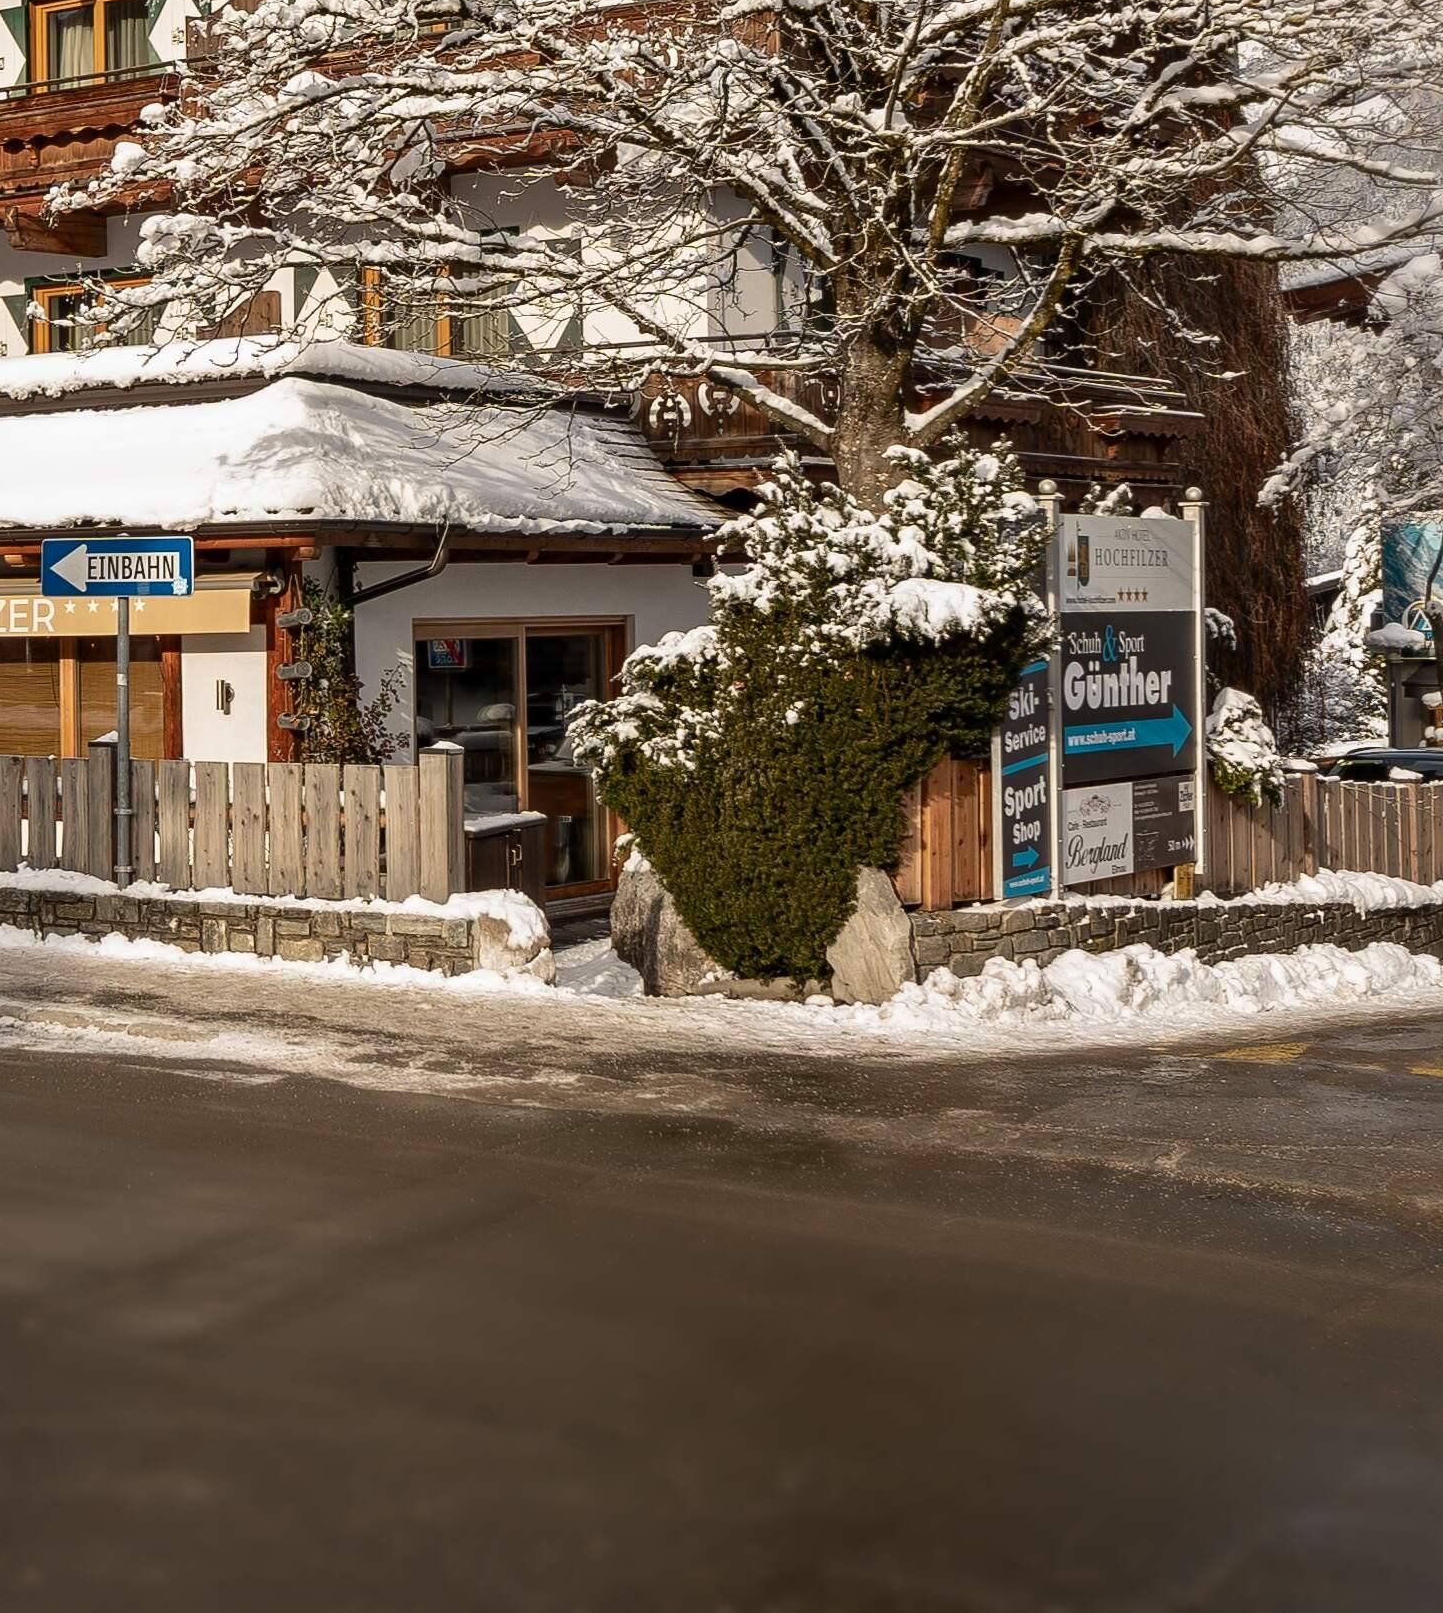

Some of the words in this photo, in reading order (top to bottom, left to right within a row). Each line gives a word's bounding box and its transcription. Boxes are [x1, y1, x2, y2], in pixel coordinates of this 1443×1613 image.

[87, 555, 175, 580] EINBAHN
[1095, 548, 1169, 567] HOCHFILZER
[1067, 631, 1102, 655] Schuh
[1102, 625, 1118, 662] &
[1118, 630, 1145, 659] Sport
[1064, 655, 1172, 711] Günther
[1008, 683, 1040, 721] Ski-
[1004, 723, 1046, 753] Service
[1004, 775, 1046, 820] Sport
[1013, 820, 1041, 844] Shop
[1065, 832, 1129, 875] Bergland
